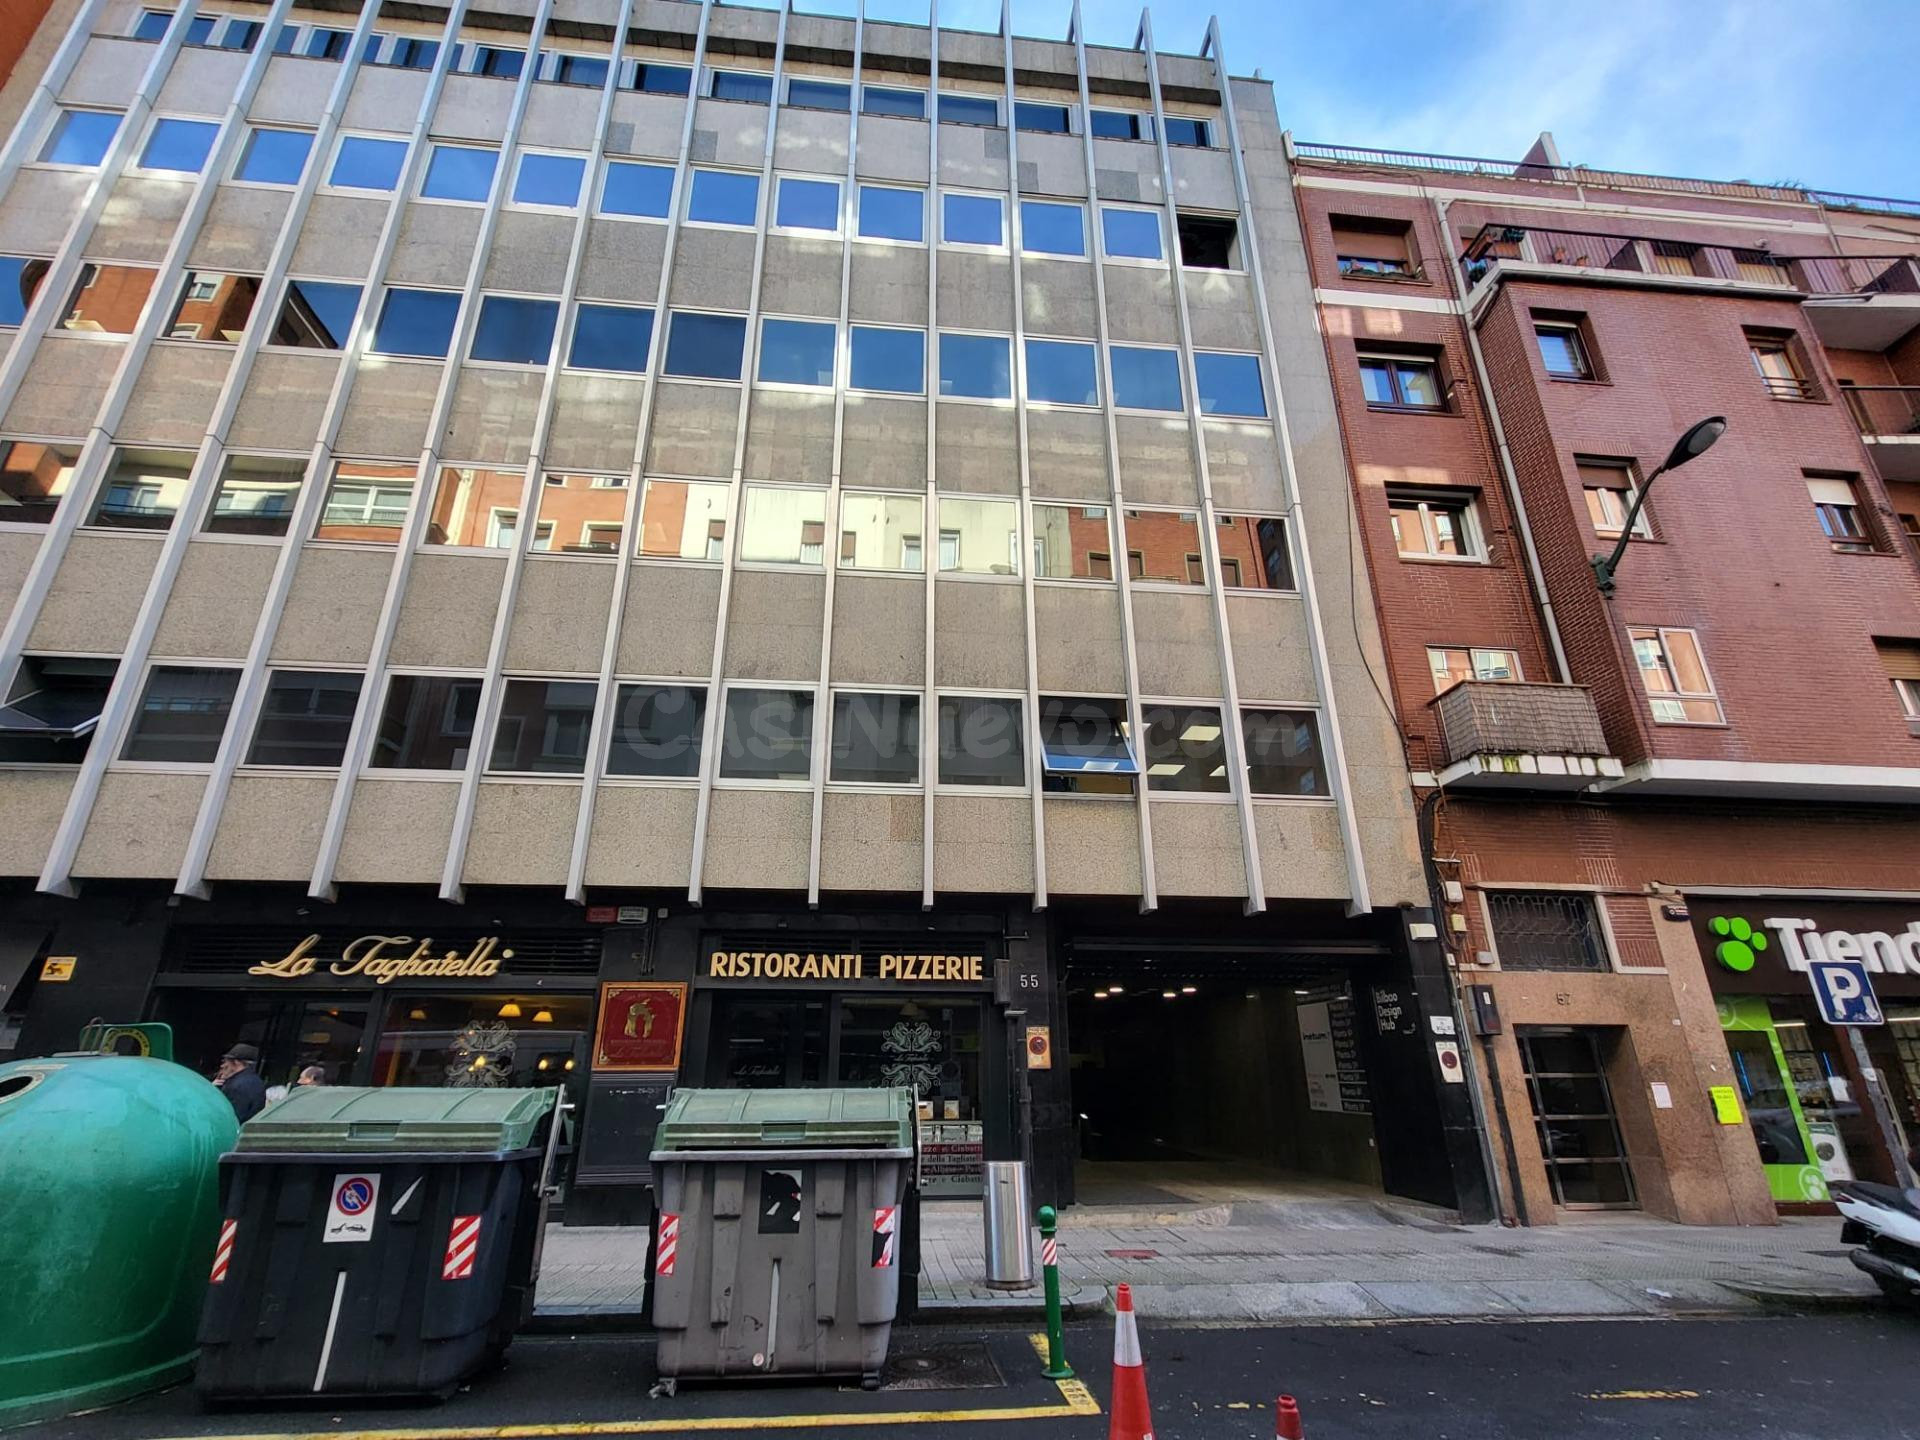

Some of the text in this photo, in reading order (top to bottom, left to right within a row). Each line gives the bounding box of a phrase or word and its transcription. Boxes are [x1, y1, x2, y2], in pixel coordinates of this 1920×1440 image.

[249, 933, 502, 985] La Tagliatella
[710, 952, 983, 981] RISTORANTI PIZZERIE
[1020, 974, 1039, 988] 55
[1556, 992, 1573, 1006] 57
[1821, 967, 1861, 1019] P
[1377, 1003, 1402, 1019] Design
[1380, 1016, 1396, 1031] Hub
